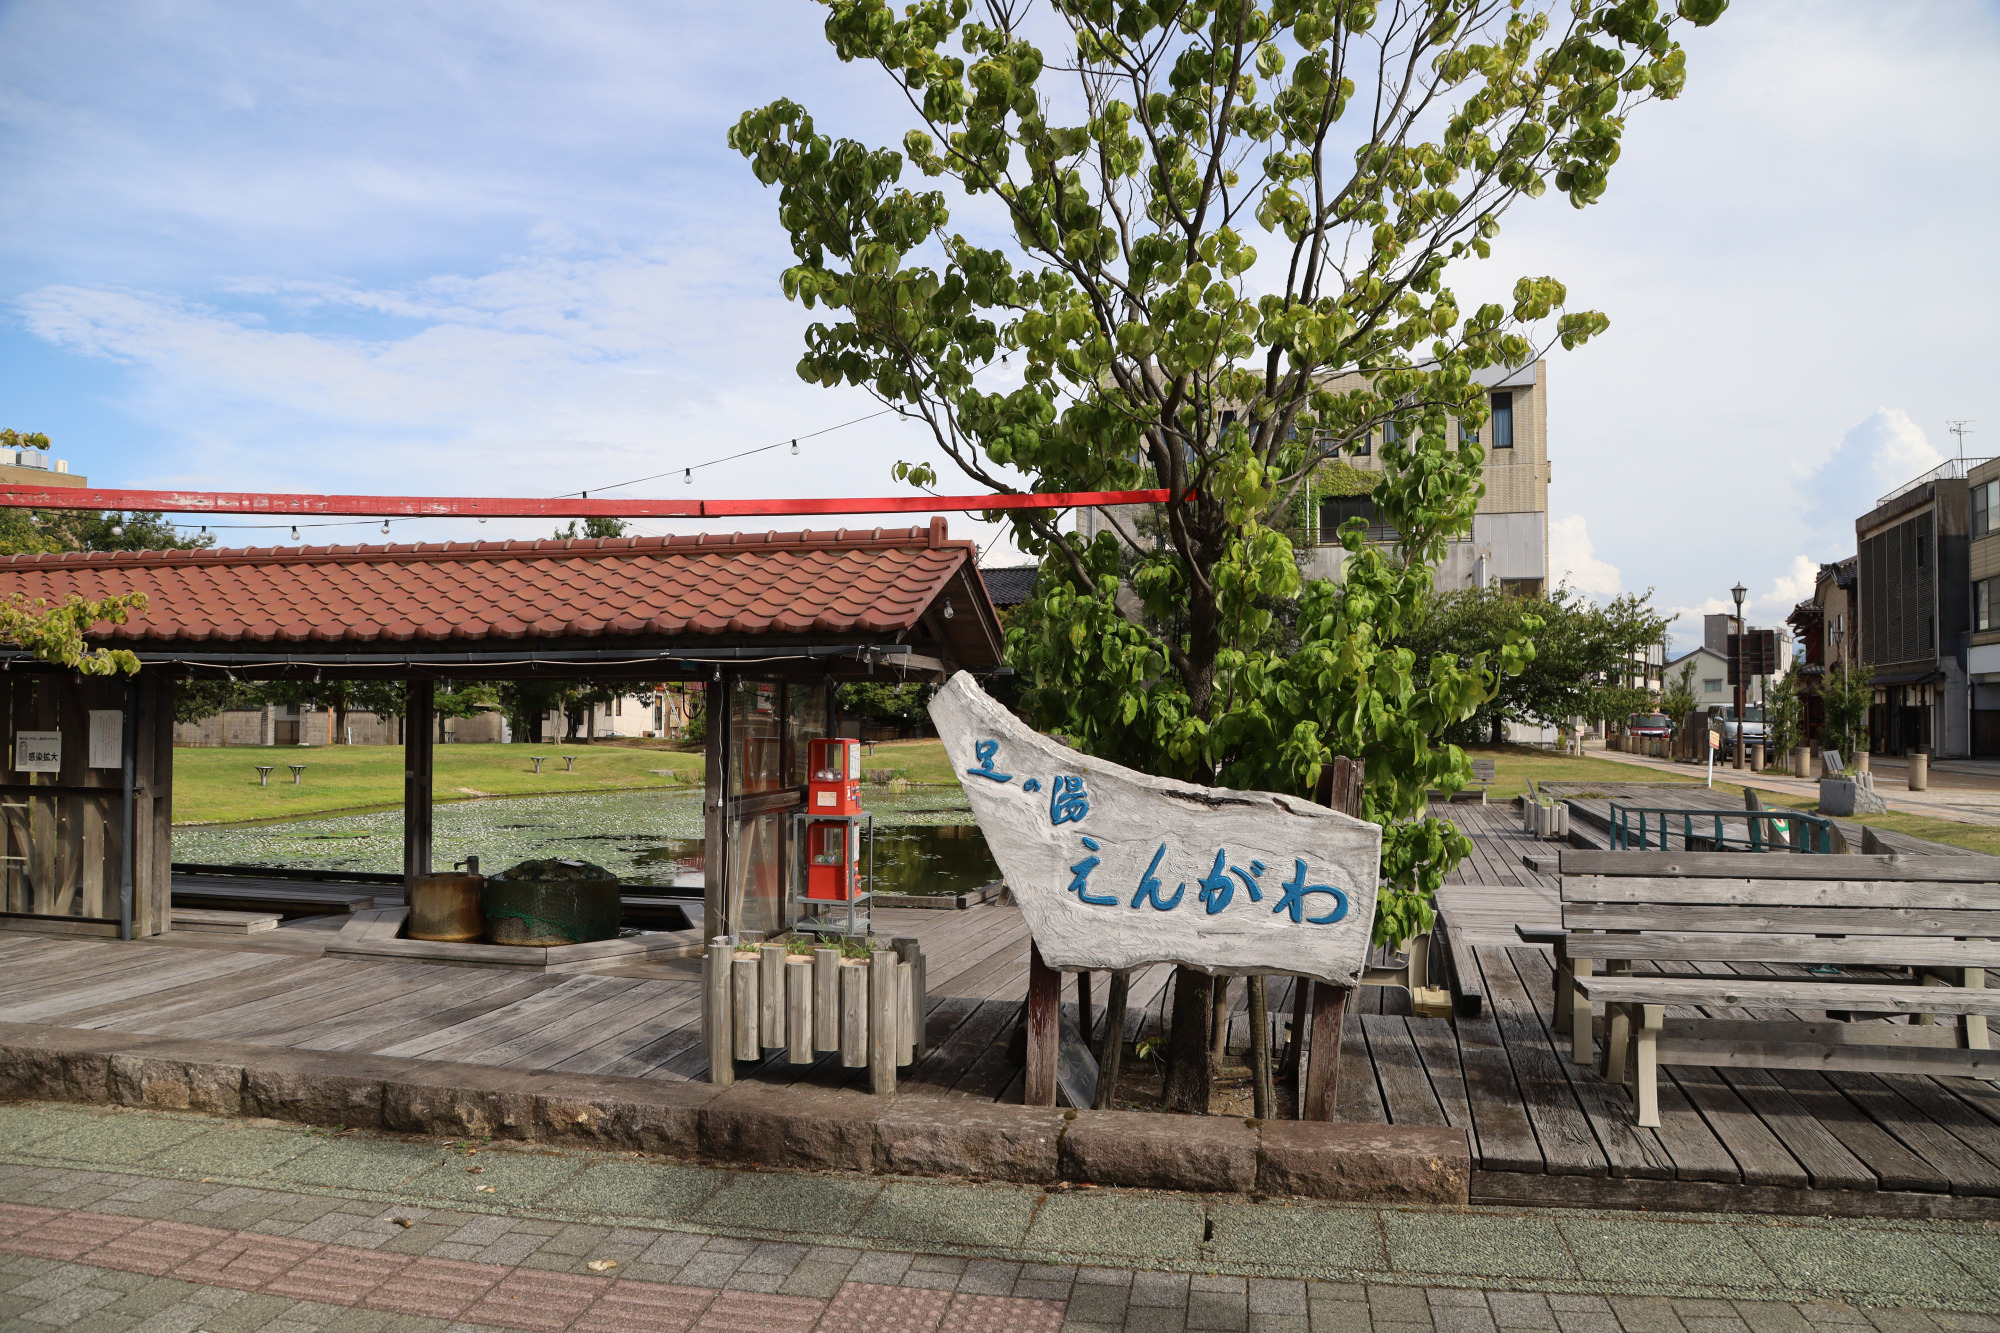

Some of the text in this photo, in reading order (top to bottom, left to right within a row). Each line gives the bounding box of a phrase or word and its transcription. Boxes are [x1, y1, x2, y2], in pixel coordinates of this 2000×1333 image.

[28, 752, 58, 762] 感染拡大
[967, 740, 1090, 825] 足の湯
[1068, 836, 1349, 924] えんがわ
